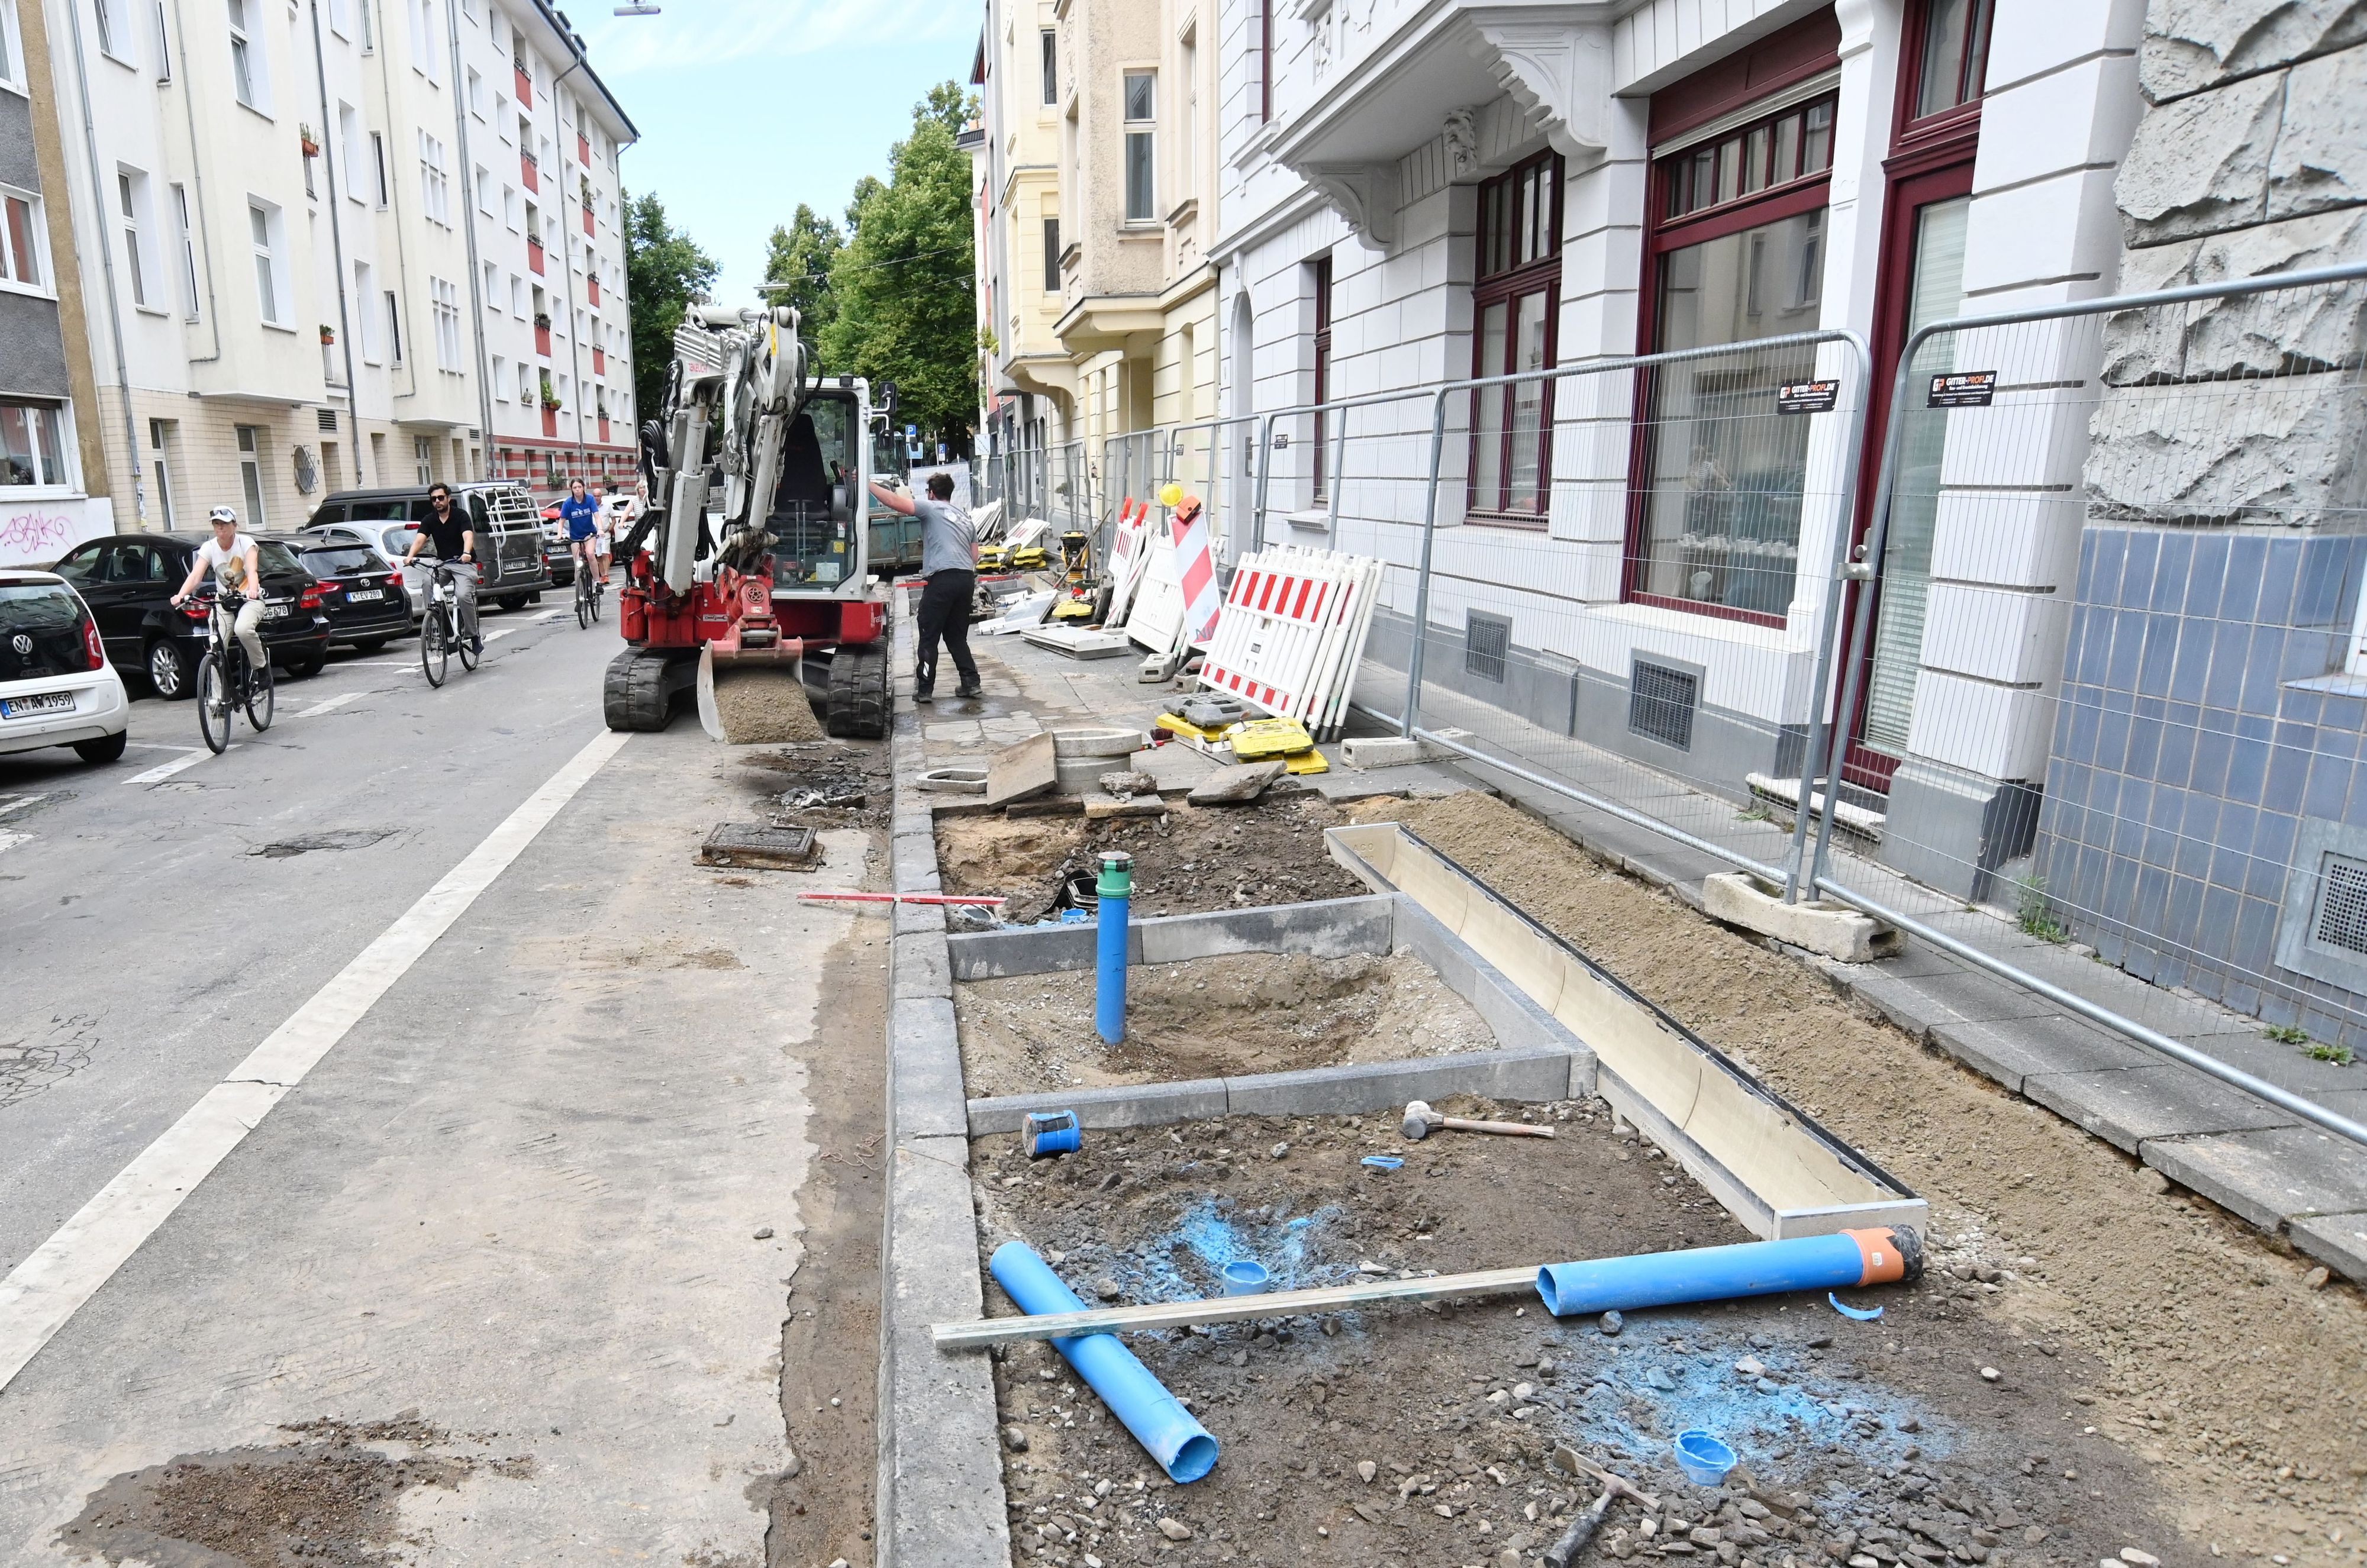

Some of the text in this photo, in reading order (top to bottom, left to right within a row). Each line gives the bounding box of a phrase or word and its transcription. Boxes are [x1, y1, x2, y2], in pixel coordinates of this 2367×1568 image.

[1946, 375, 1994, 386] GITTER-PROFI.DE
[1792, 383, 1835, 393] GITTER-PROFI.DE
[907, 427, 914, 435] P
[274, 606, 287, 616] 678
[7, 700, 24, 712] EN
[45, 694, 71, 708] 1959
